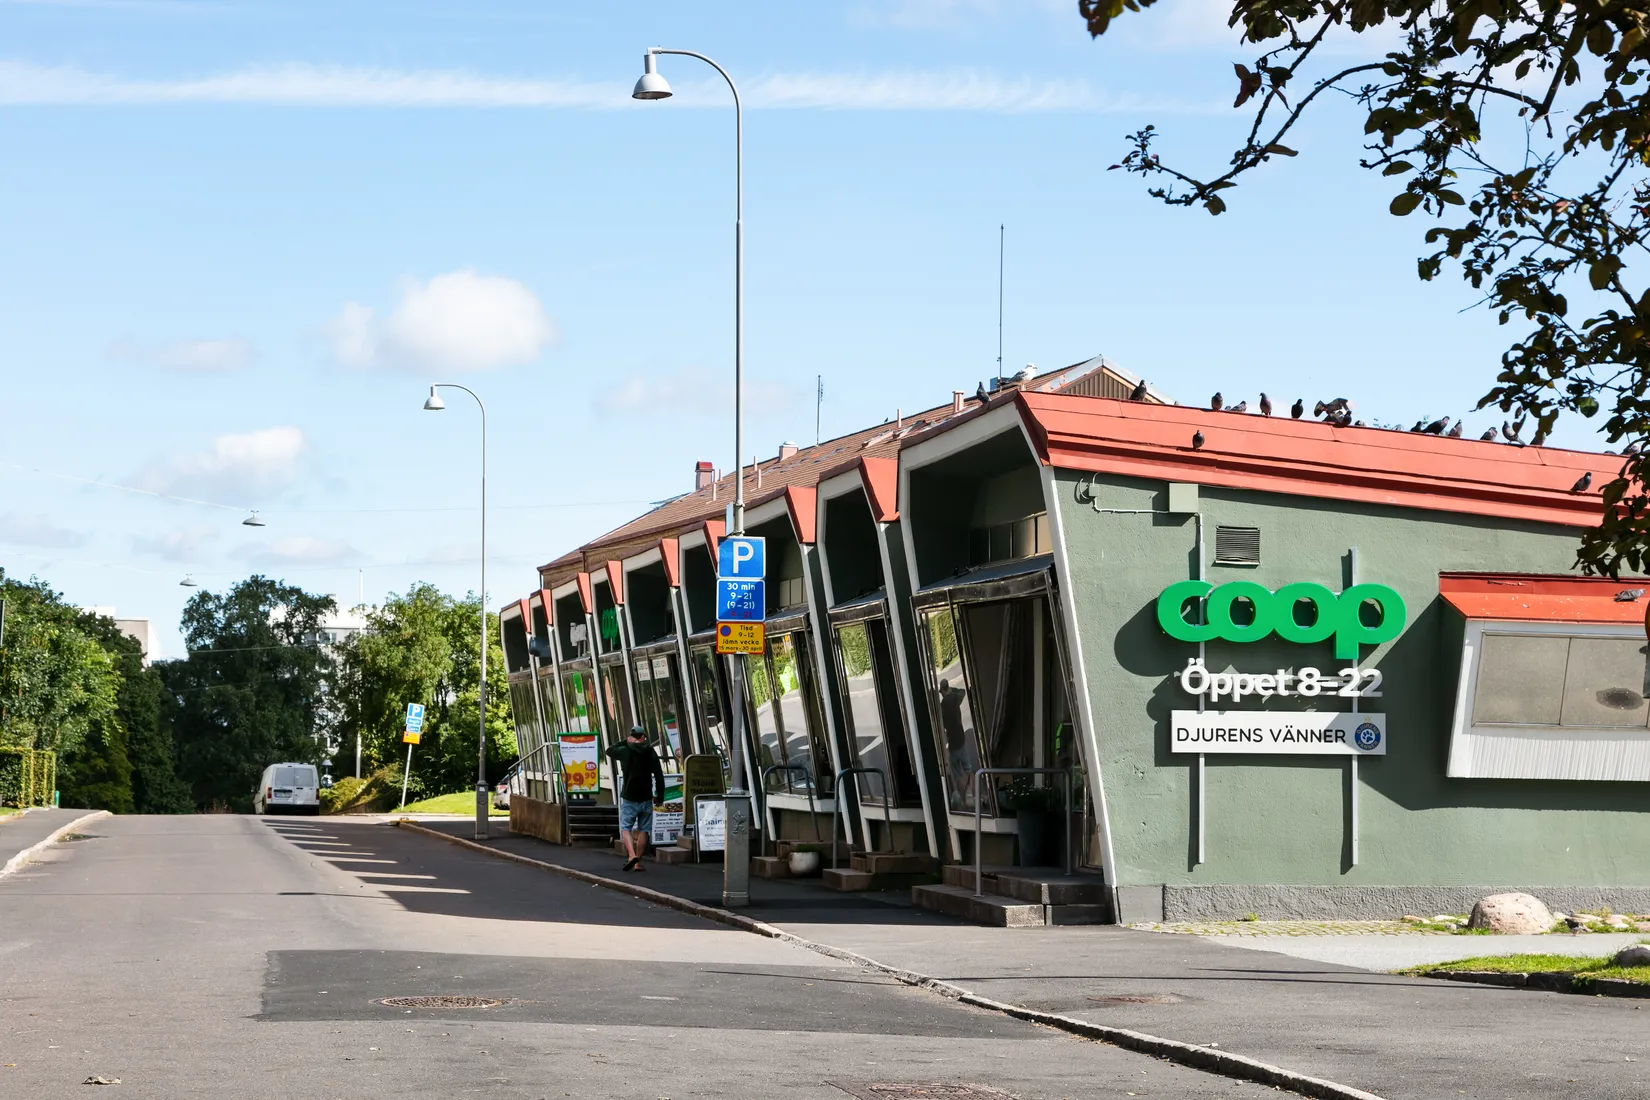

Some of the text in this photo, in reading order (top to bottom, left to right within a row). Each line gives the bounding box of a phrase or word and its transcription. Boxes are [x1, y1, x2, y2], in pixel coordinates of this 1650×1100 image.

[732, 541, 754, 574] P
[1155, 580, 1407, 660] coop
[1180, 658, 1290, 703] Öppet
[412, 705, 421, 717] P
[1177, 726, 1346, 743] DJURENS VÄNNER
